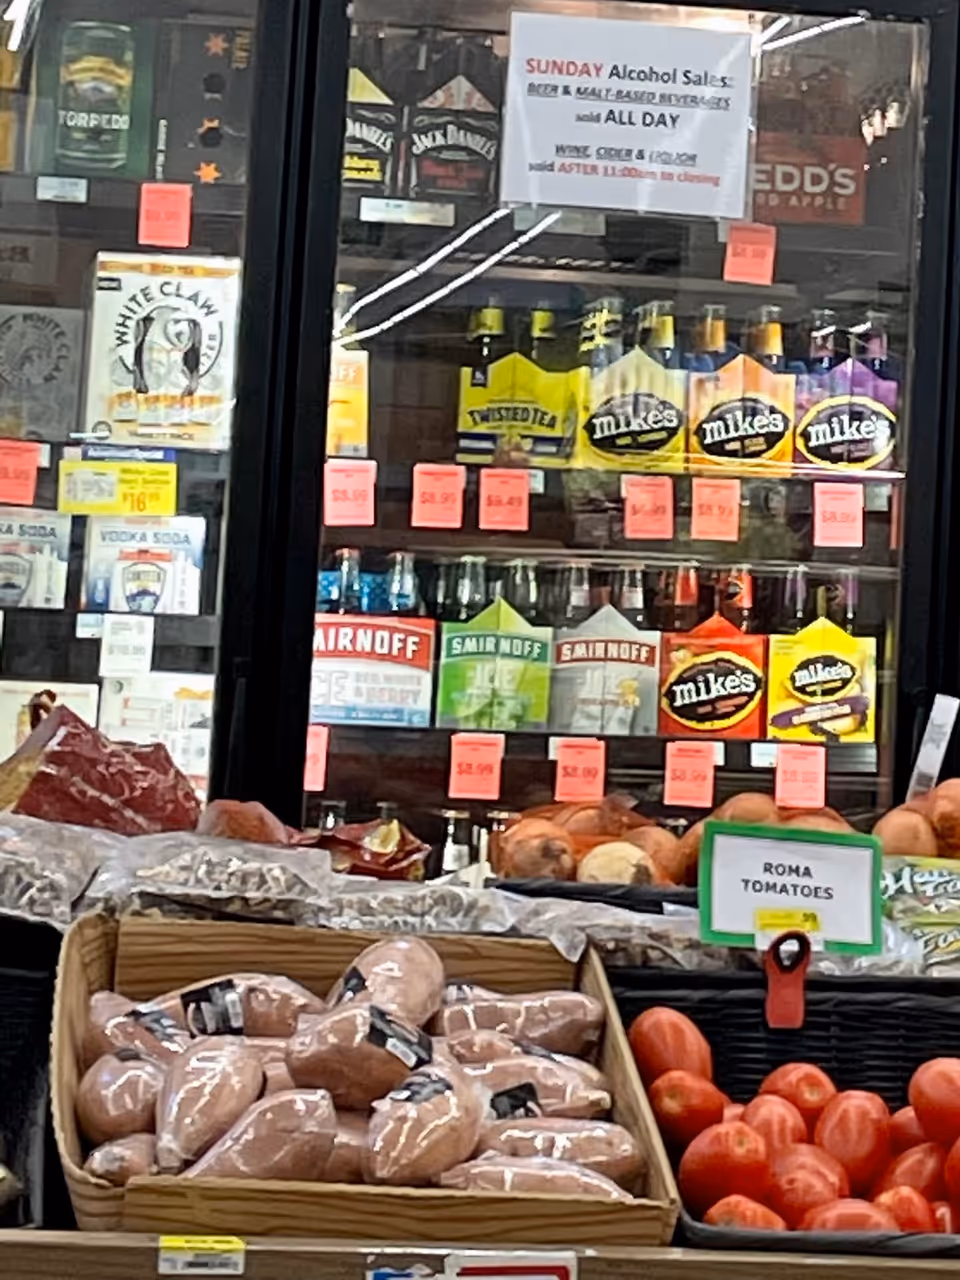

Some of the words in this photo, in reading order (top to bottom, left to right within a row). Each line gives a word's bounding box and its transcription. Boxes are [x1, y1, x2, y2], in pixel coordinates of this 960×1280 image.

[526, 58, 603, 77] SUNDAY
[609, 65, 677, 85] Alcohol
[527, 82, 559, 97] BEER
[561, 85, 572, 96] &
[575, 86, 656, 104] MALT-BASED
[58, 109, 130, 131] TORPEDO
[604, 109, 637, 127] ALL
[641, 112, 681, 129] DAY
[412, 130, 446, 154] JACK
[635, 149, 645, 160] &
[557, 163, 599, 176] AFTER
[754, 163, 857, 196] EDD'S
[113, 285, 155, 348] WHITE
[160, 281, 219, 318] CLAW
[467, 406, 530, 426] TWISTED
[531, 409, 557, 430] TEA
[592, 405, 678, 440] mike's
[703, 410, 785, 445] mike's
[808, 414, 891, 447] mike's
[18, 524, 57, 539] SODA
[100, 530, 147, 544] VODKA
[152, 532, 192, 545] SODA
[313, 626, 420, 659] MIRNOFF
[452, 637, 541, 660] SMIRNOFF
[560, 639, 650, 662] SMIRNOFF
[793, 662, 854, 687] mike's
[671, 670, 757, 708] mike's
[763, 862, 814, 880] ROMA
[741, 879, 834, 901] TOMATOES
